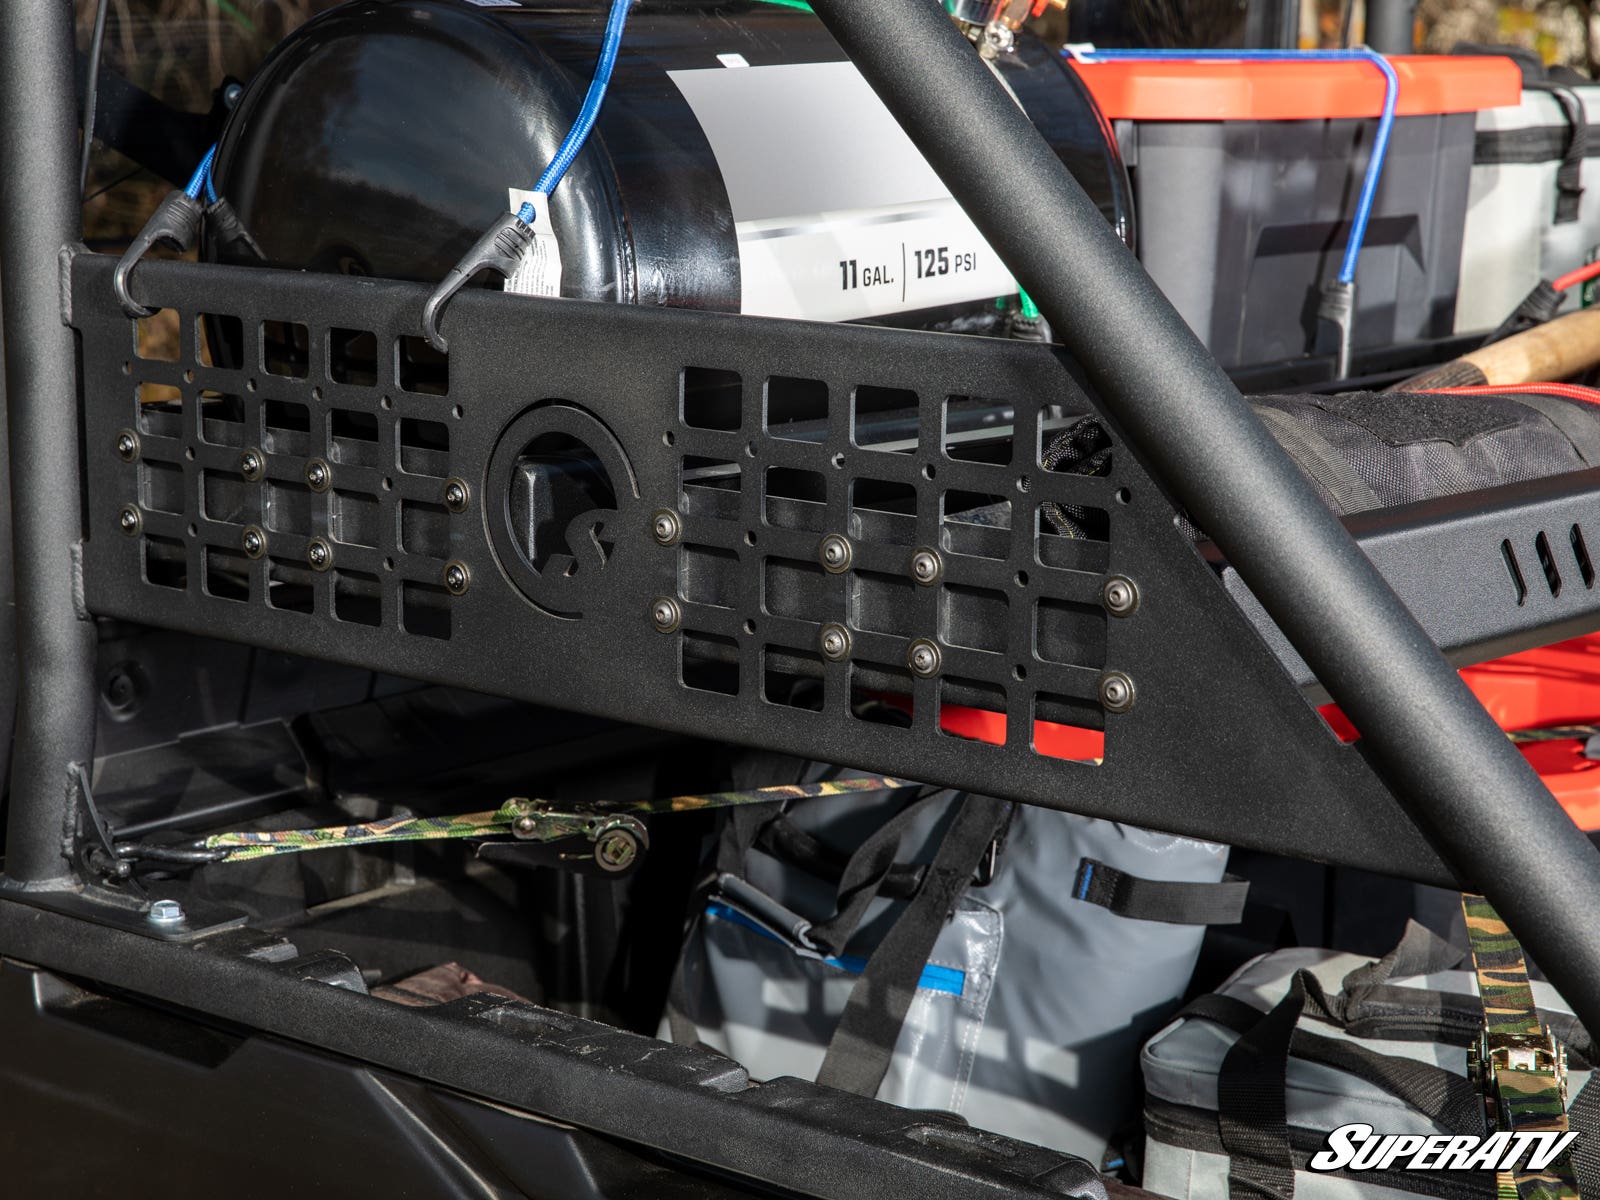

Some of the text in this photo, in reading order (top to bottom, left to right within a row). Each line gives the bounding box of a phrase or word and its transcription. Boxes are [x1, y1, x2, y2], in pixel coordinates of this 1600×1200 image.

[839, 259, 894, 290] 11 GAL.
[914, 247, 976, 279] 125 PSI
